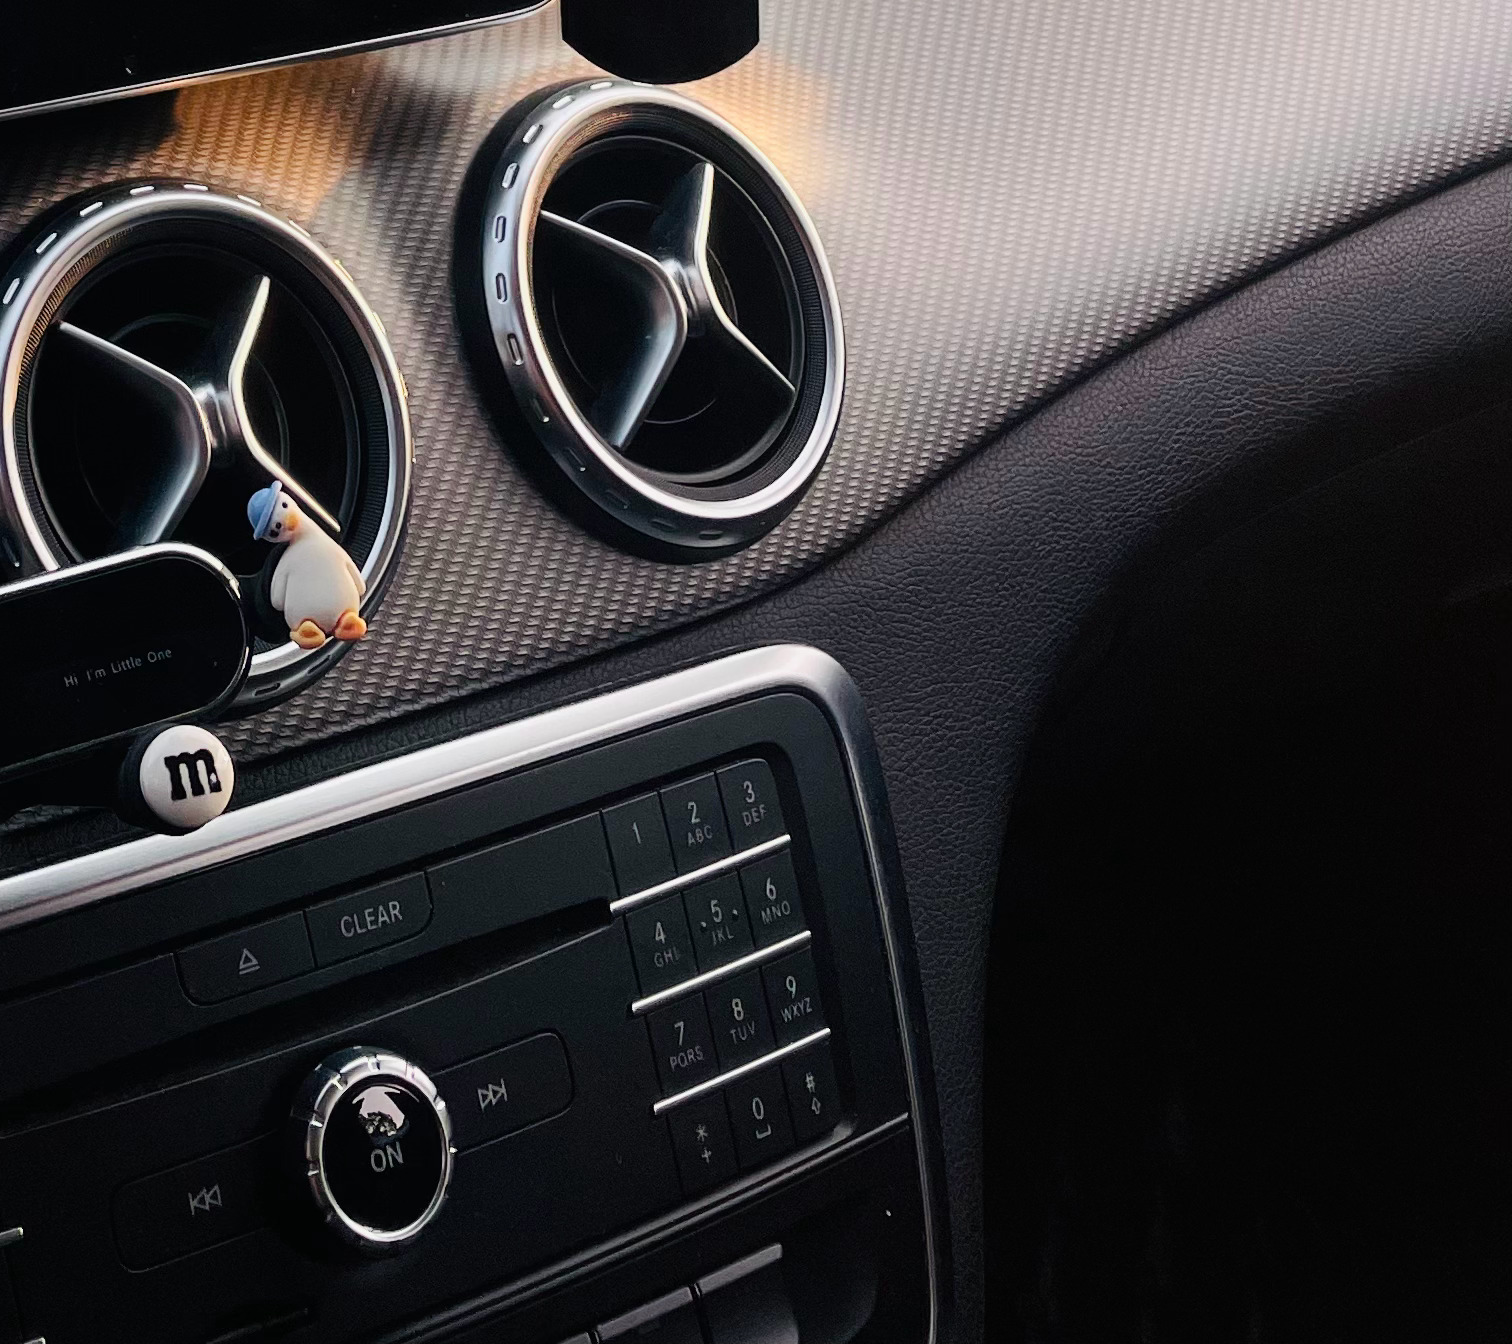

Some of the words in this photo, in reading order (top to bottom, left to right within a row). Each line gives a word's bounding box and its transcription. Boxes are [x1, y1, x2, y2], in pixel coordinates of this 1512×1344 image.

[63, 672, 79, 688] Hi
[110, 655, 143, 674] Little
[147, 646, 172, 664] One
[163, 747, 223, 802] m
[743, 780, 756, 804] 3
[687, 800, 702, 826] 2
[743, 803, 767, 827] DEF
[631, 821, 643, 845] 1
[688, 824, 713, 847] ABC
[765, 876, 778, 902] 6
[339, 899, 404, 939] CLEAR
[710, 898, 724, 923] 5
[760, 900, 791, 924] MNO
[653, 920, 667, 945] 4
[711, 926, 735, 946] JKL
[785, 974, 798, 1000] 9
[731, 997, 745, 1021] 8
[780, 996, 813, 1023] WXYZ
[673, 1020, 686, 1047] 7
[729, 1020, 756, 1045] TUV
[751, 1096, 765, 1121] 0
[369, 1141, 406, 1174] ON
